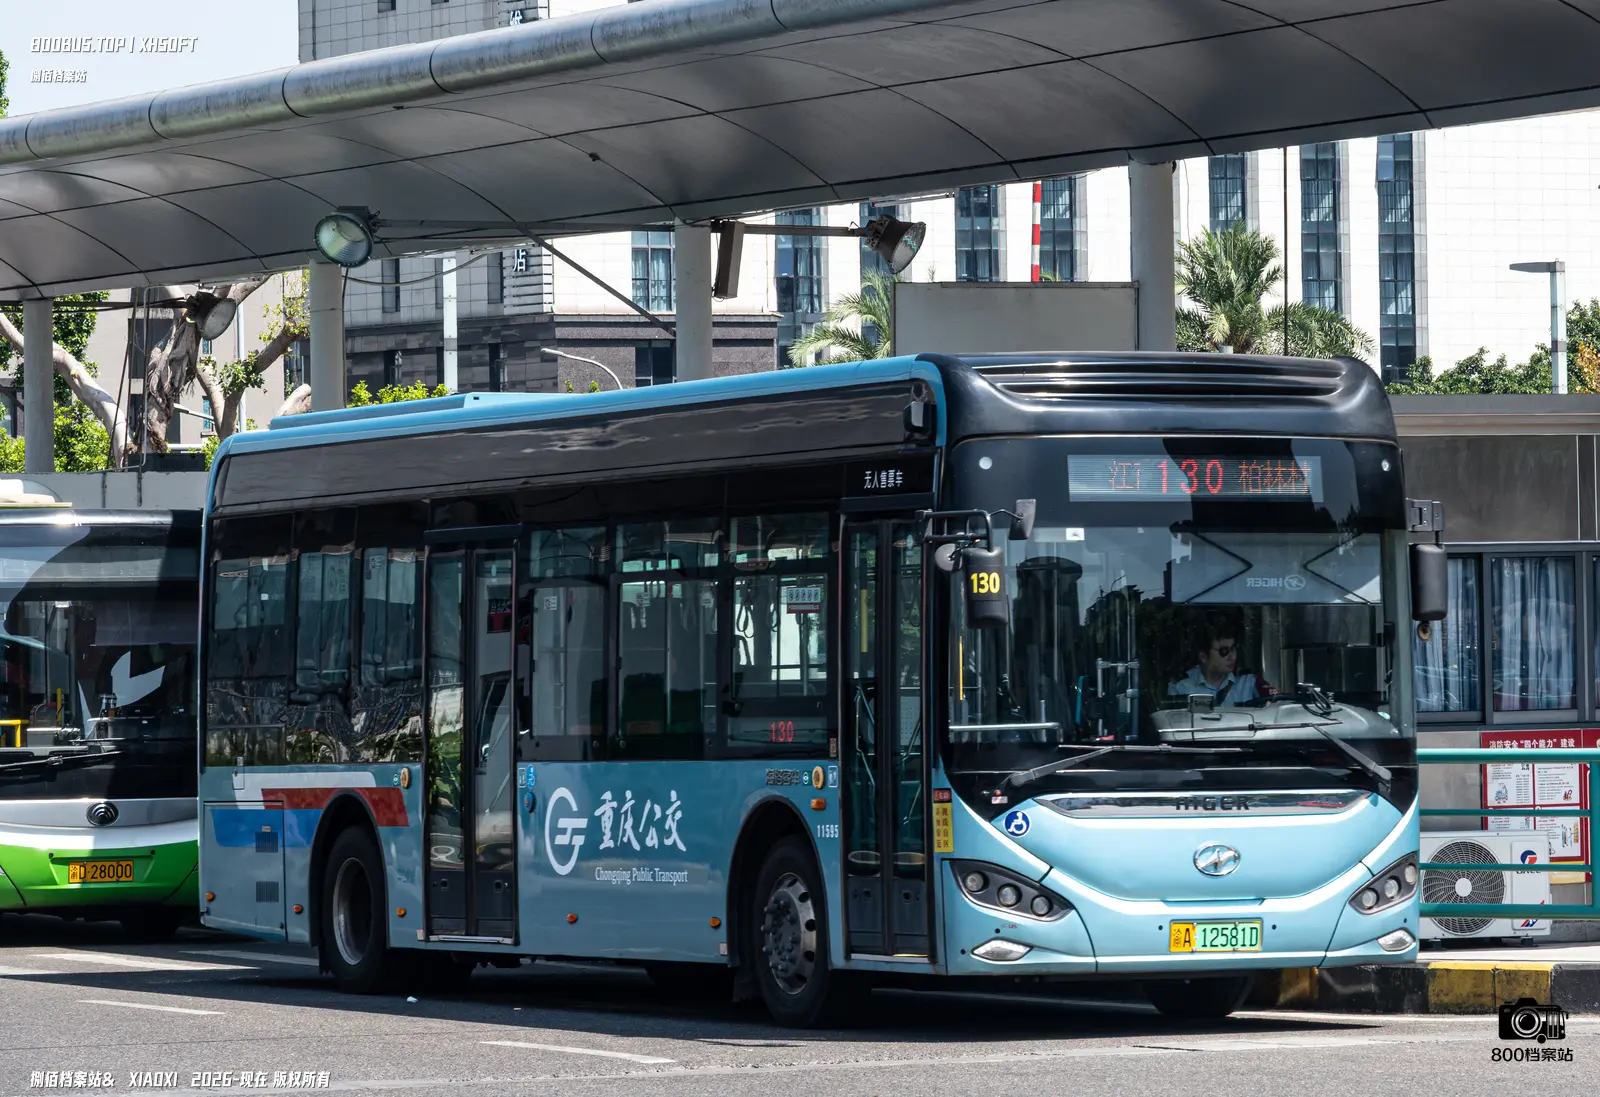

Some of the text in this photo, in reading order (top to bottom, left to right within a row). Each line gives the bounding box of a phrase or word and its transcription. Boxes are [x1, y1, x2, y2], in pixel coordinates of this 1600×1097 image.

[864, 469, 903, 489] 无人售票车
[1157, 459, 1224, 494] 130
[970, 571, 1000, 594] 130
[769, 721, 794, 742] 130
[1175, 795, 1250, 811] HIGER
[594, 790, 686, 851] 重庆公交
[816, 824, 839, 838] 11595
[595, 866, 688, 885] Chongqing Public Transport
